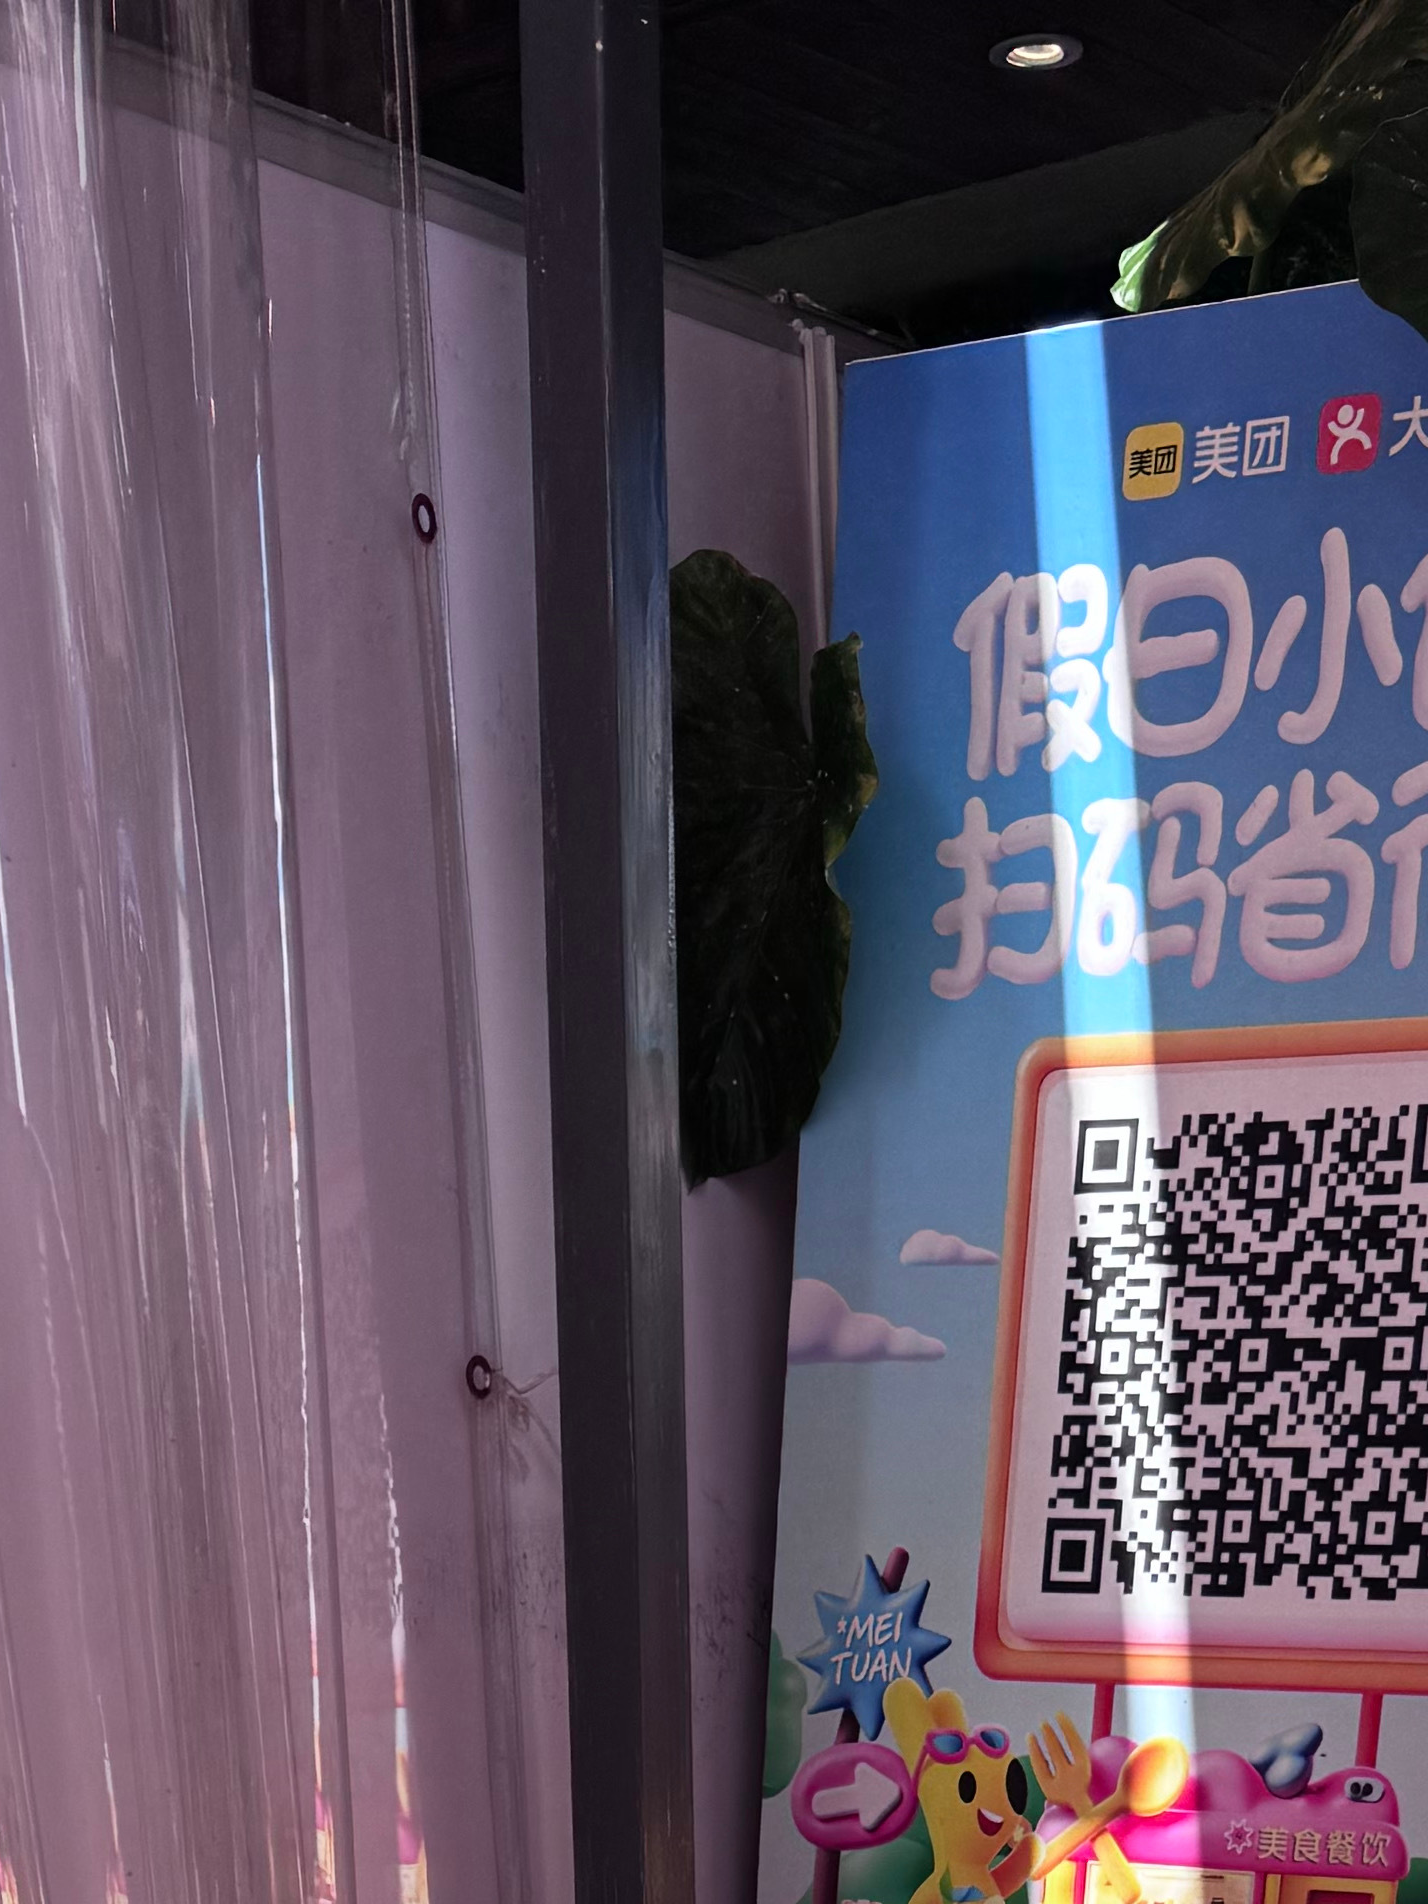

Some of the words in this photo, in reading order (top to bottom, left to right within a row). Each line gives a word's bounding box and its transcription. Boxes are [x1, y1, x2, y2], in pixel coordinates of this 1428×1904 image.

[1128, 445, 1178, 479] 美团
[1191, 415, 1290, 485] 美团
[845, 1611, 903, 1649] MEI
[830, 1646, 912, 1685] TUAN
[1258, 1827, 1391, 1868] 美食餐饮
